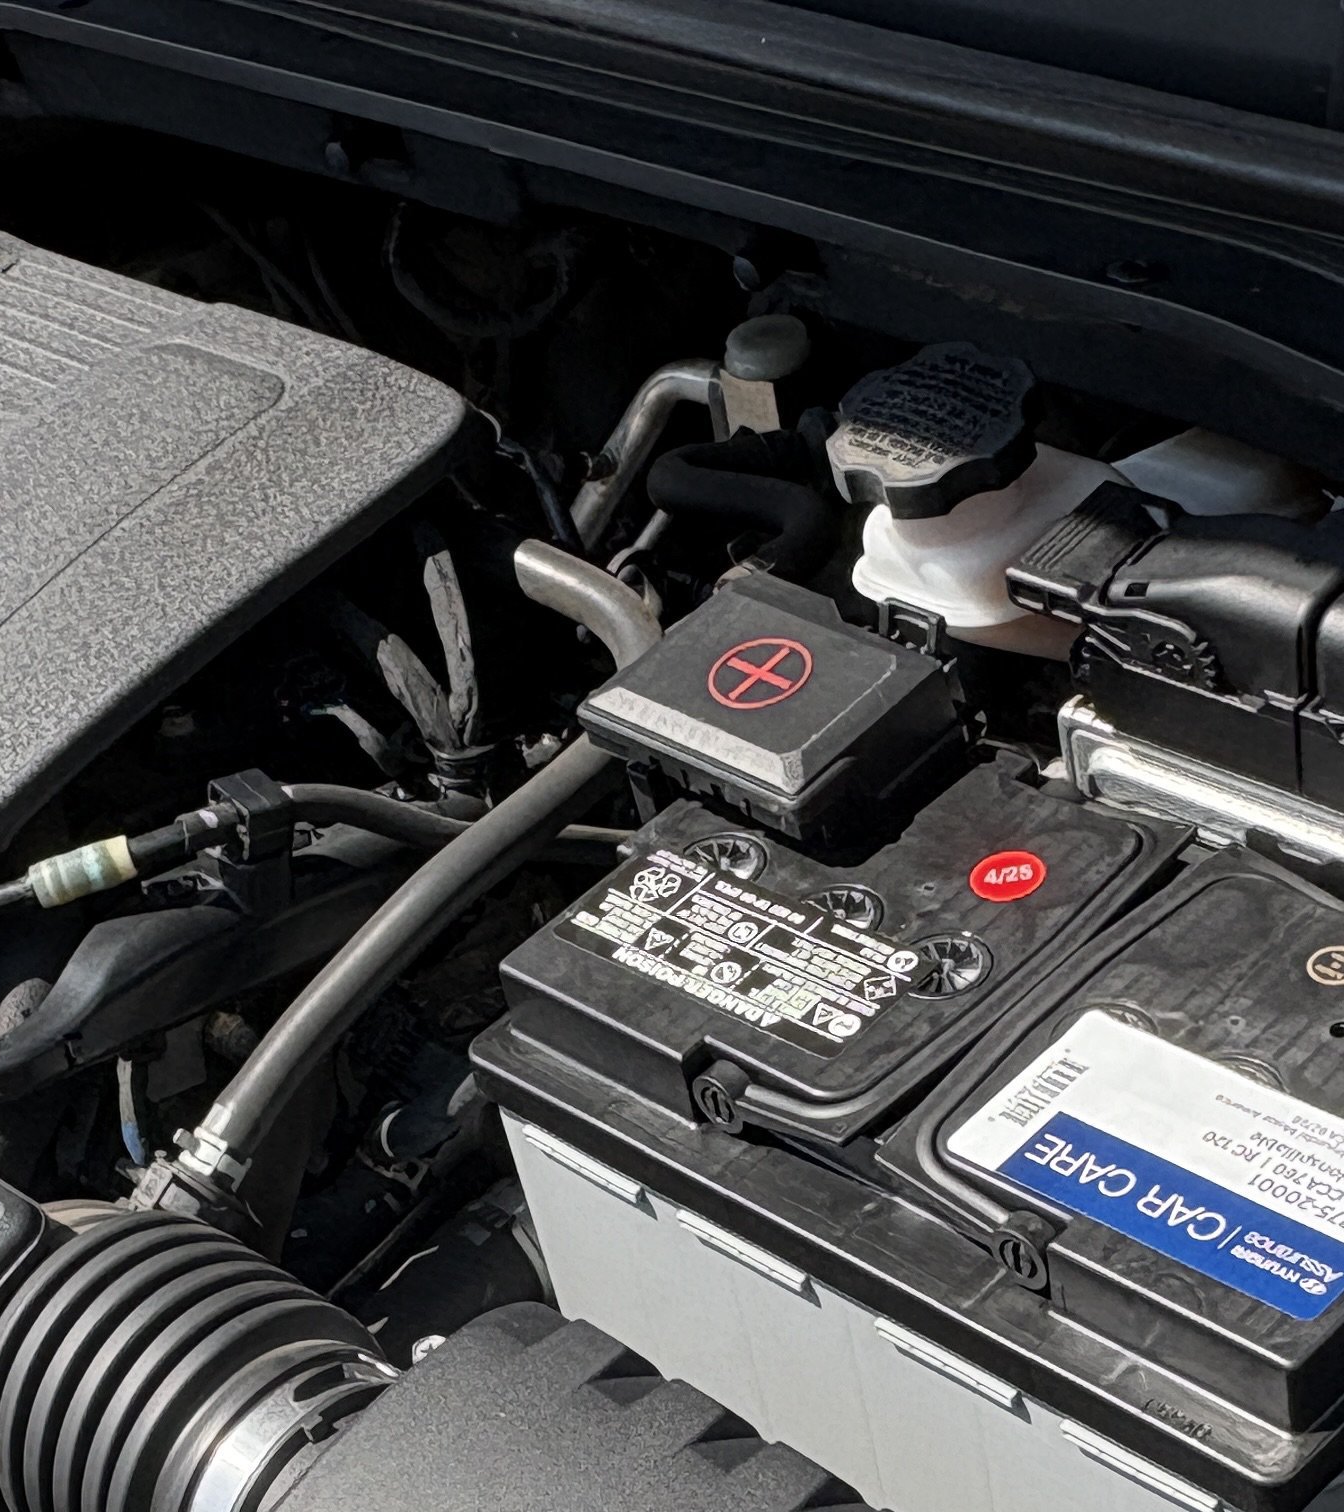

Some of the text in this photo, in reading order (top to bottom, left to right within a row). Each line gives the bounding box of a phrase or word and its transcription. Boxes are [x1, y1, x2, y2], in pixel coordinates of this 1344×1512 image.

[983, 863, 1034, 885] 4/25
[1230, 1144, 1258, 1163] RC
[1024, 1133, 1230, 1241] CAR CARE
